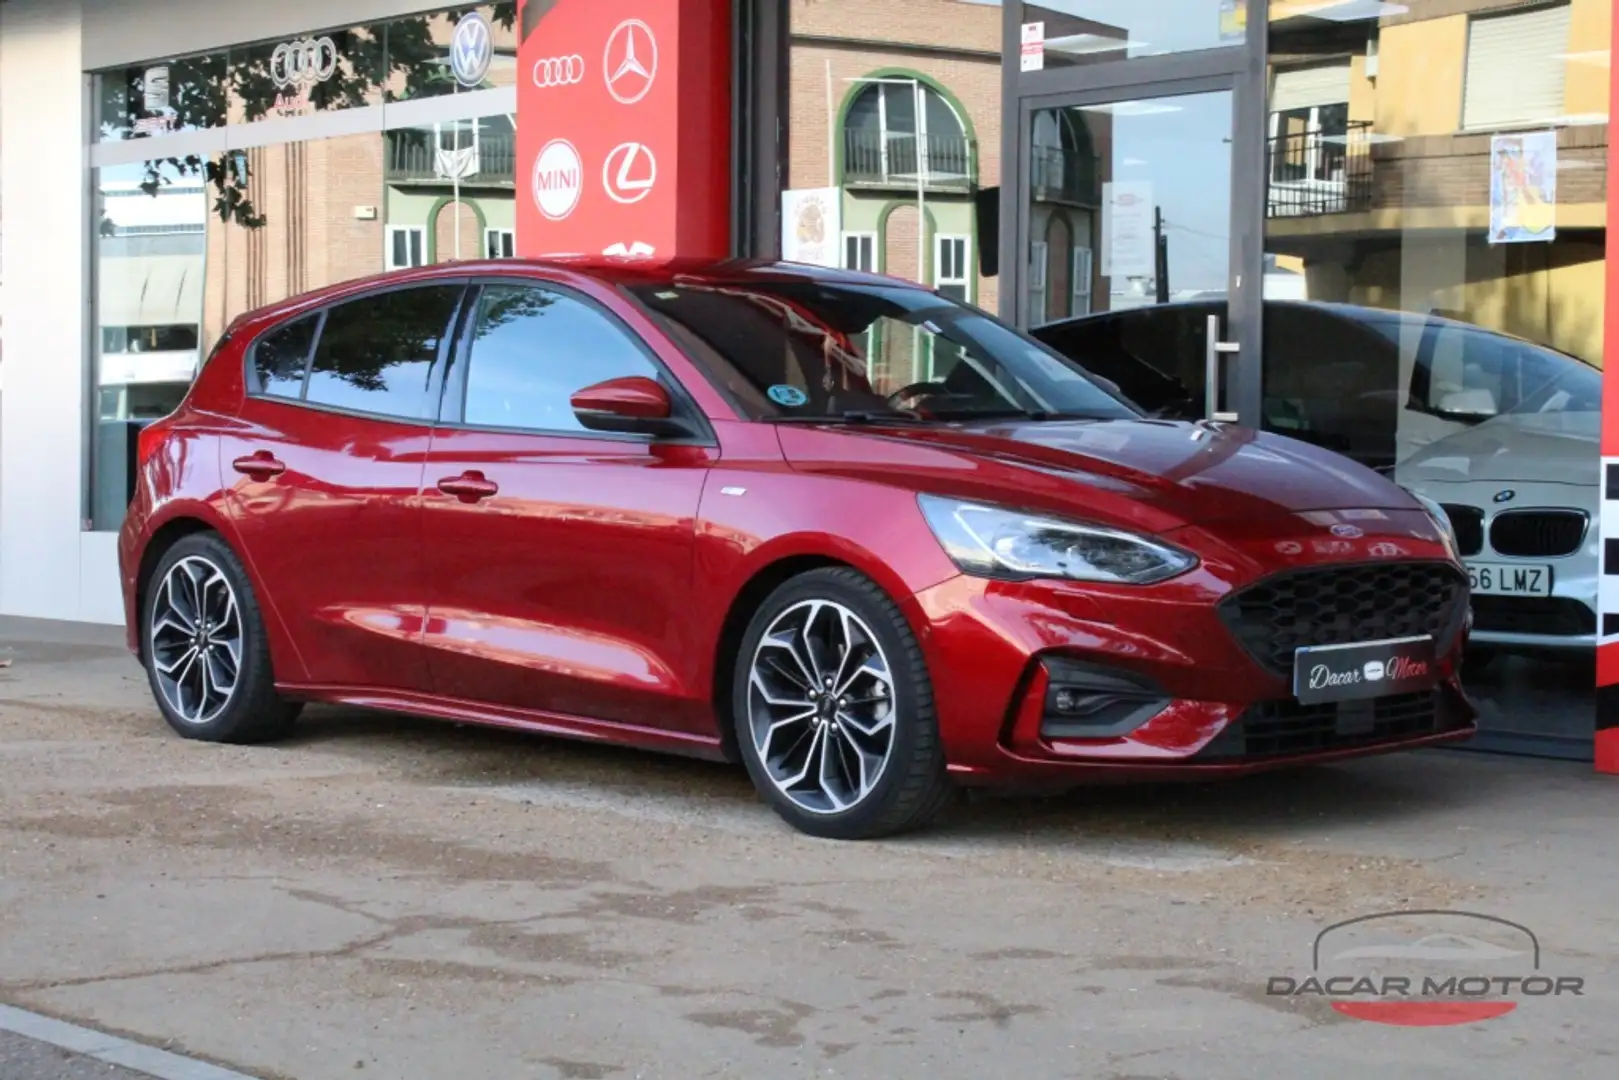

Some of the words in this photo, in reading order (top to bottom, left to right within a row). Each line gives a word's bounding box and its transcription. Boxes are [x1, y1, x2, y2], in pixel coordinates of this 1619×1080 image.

[537, 167, 577, 191] MINI
[1500, 567, 1542, 593] LMZ
[1308, 663, 1361, 689] Dacar
